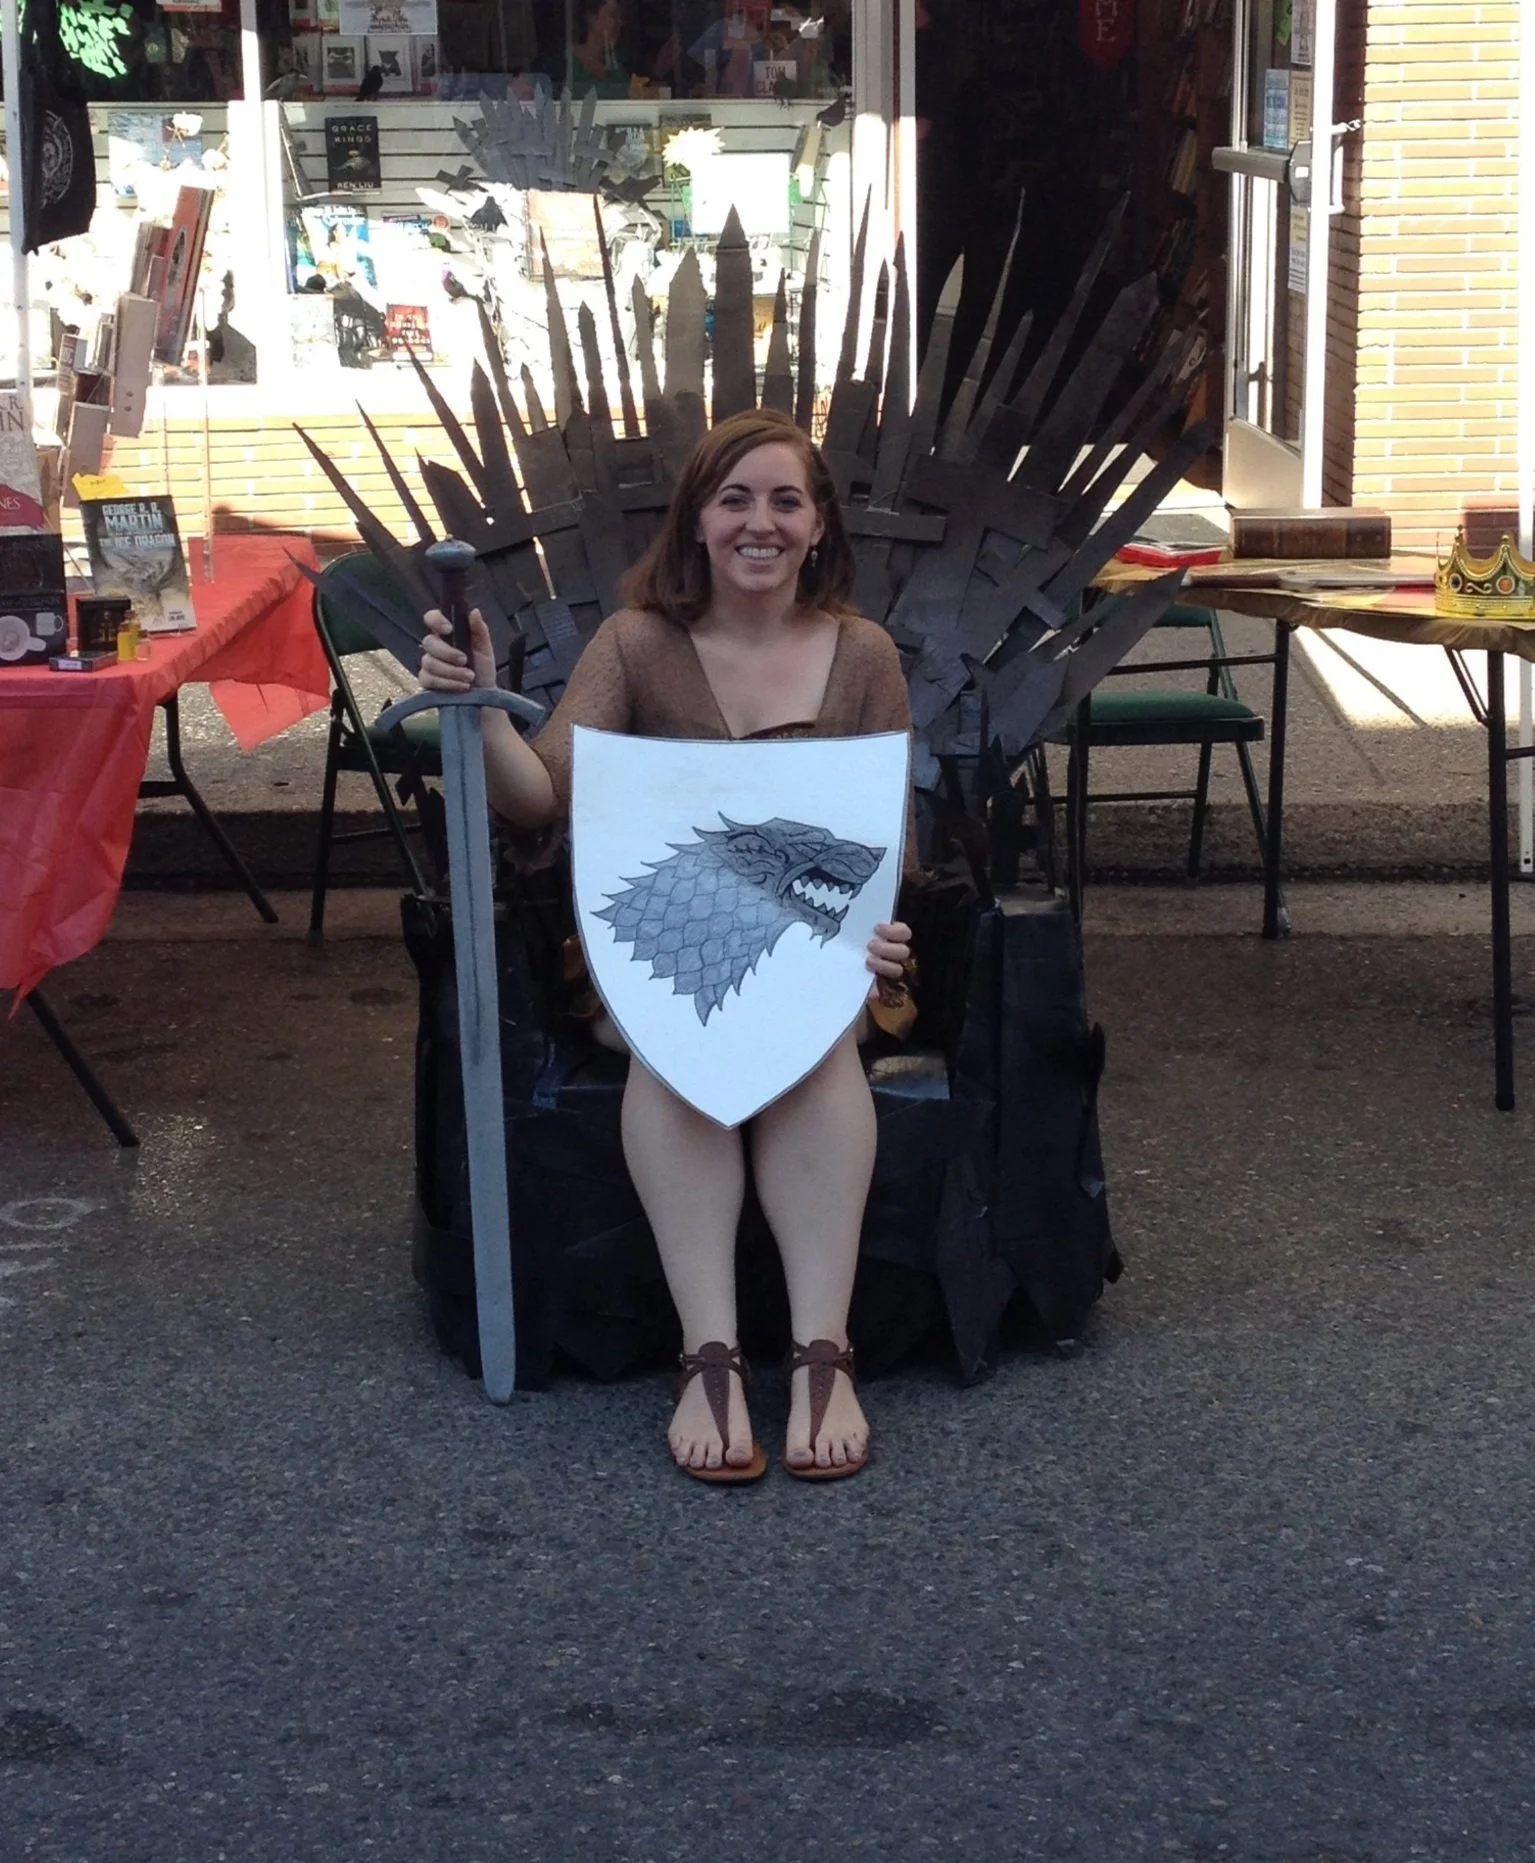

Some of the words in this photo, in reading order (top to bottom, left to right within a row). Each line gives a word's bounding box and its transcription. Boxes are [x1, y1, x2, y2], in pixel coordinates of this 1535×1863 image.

[331, 124, 373, 133] GRACE
[334, 135, 372, 143] KINGS
[337, 181, 355, 189] KEN
[102, 503, 138, 516] GEORGE
[104, 512, 164, 533] MARTIN
[113, 536, 132, 549] ICE
[134, 533, 176, 549] DRAGON
